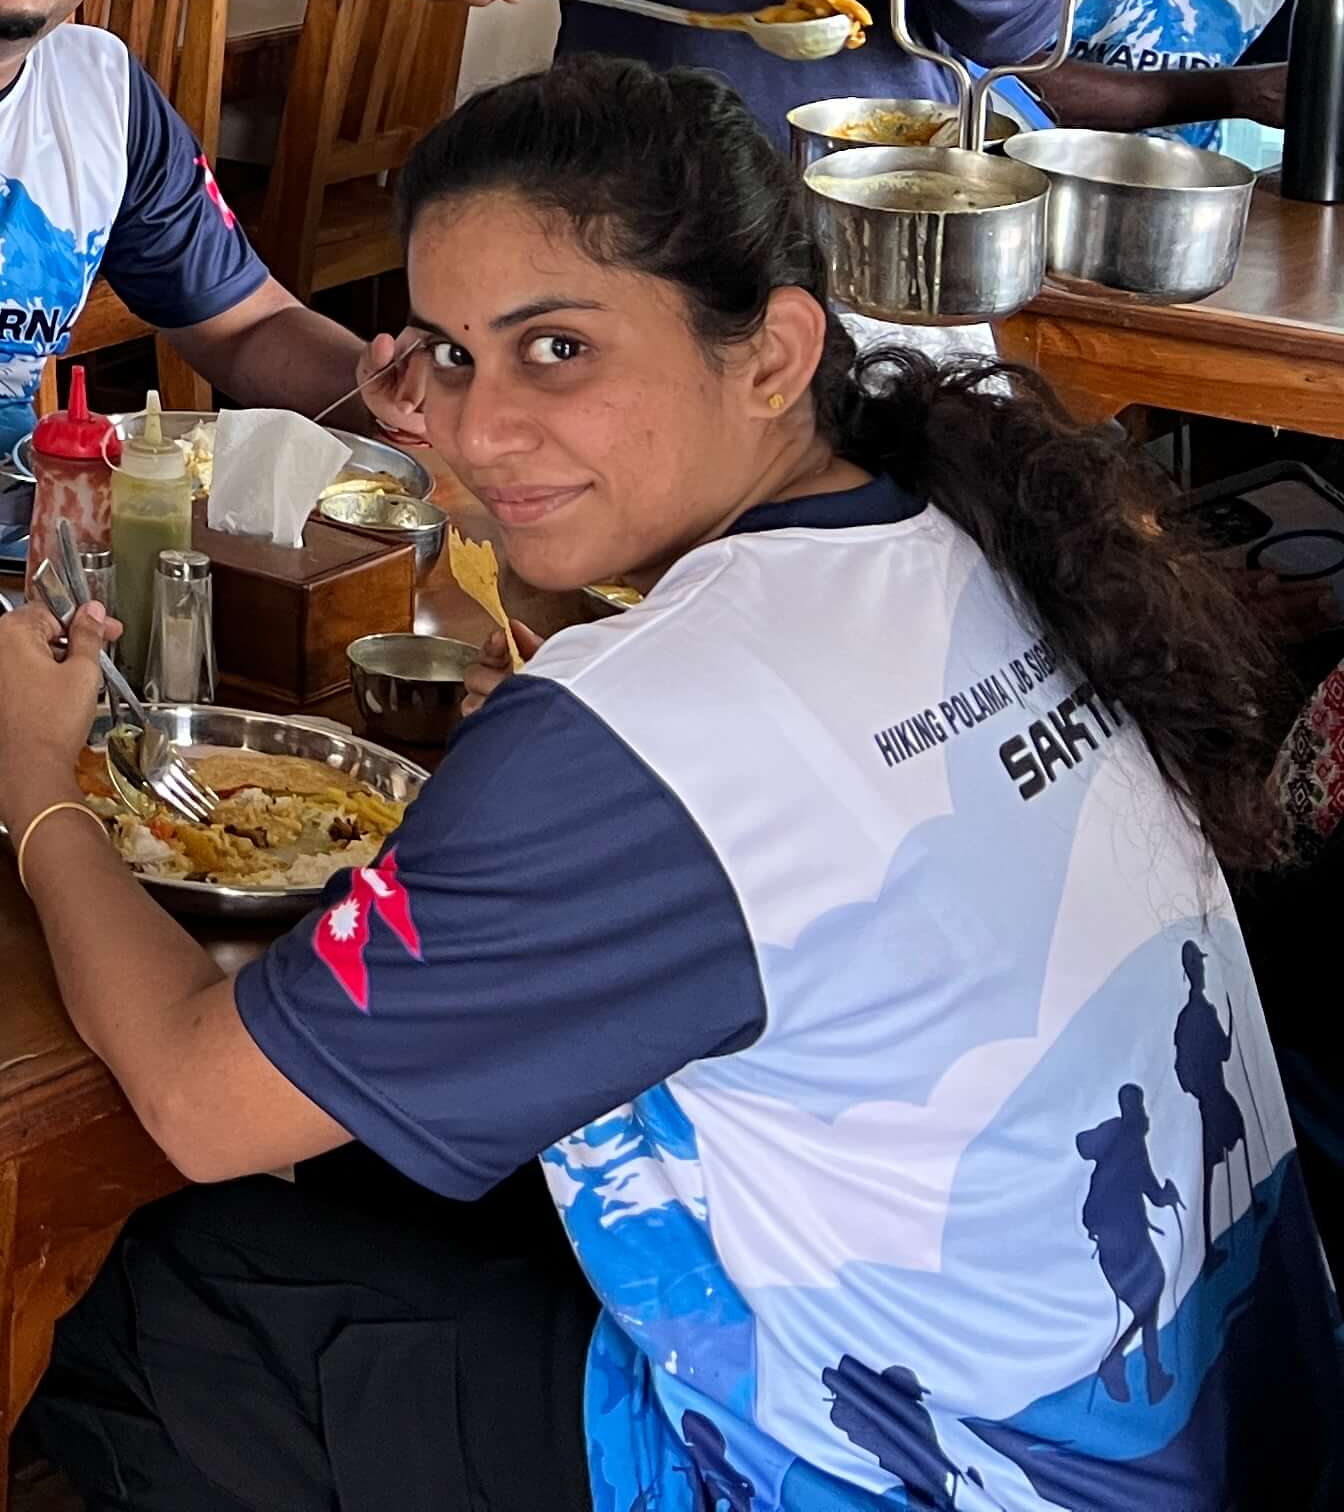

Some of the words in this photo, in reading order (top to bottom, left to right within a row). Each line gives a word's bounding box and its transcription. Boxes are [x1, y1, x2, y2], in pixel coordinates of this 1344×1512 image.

[874, 708, 949, 768] HIKING
[938, 674, 1014, 735] POLAMA
[1009, 659, 1034, 695] JB
